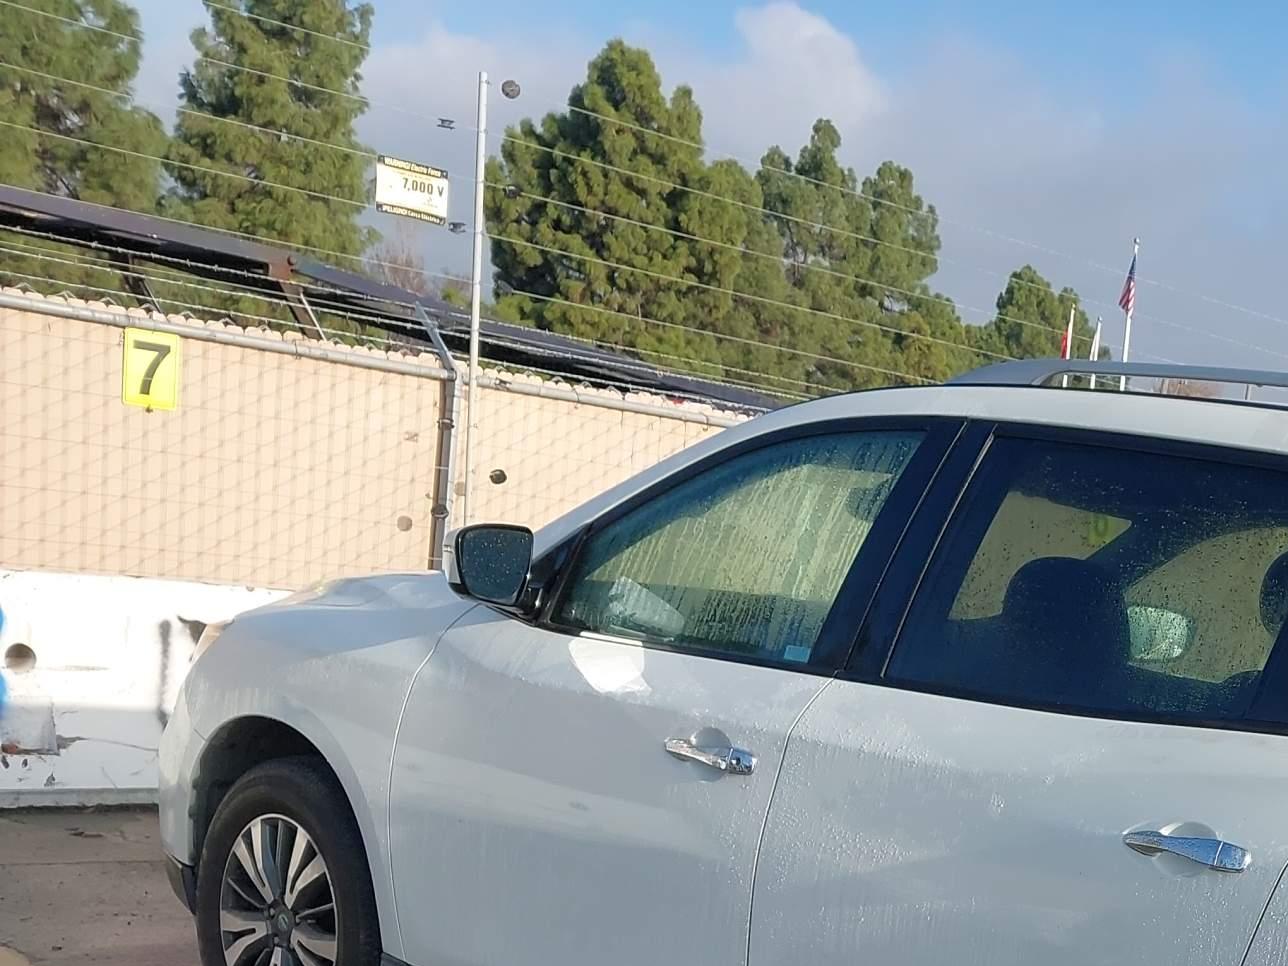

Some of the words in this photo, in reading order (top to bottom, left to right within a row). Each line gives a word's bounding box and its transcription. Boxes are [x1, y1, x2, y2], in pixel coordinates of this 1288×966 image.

[402, 177, 434, 195] 7,000
[437, 185, 445, 197] V
[133, 339, 171, 395] 7
